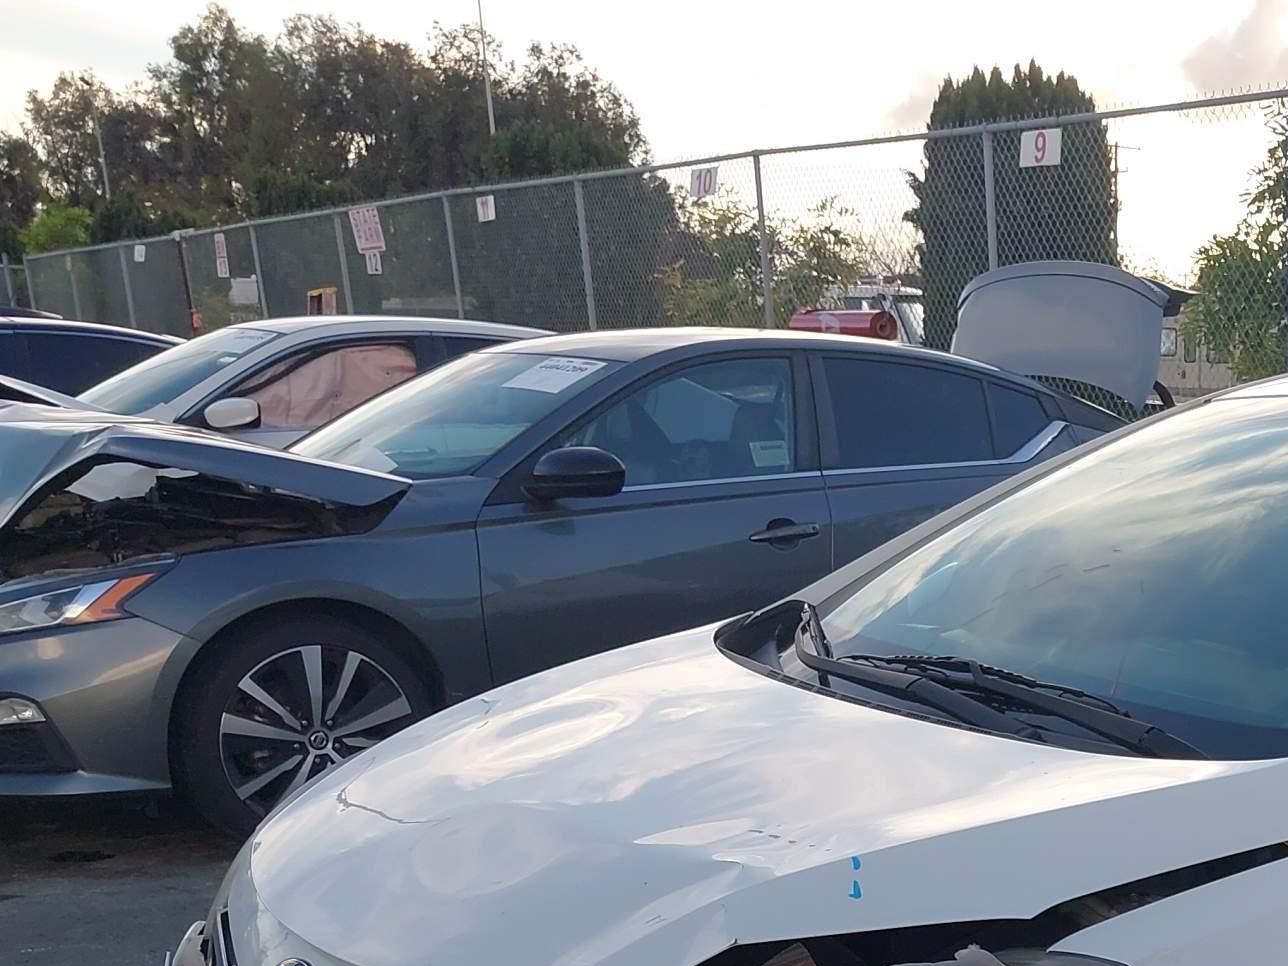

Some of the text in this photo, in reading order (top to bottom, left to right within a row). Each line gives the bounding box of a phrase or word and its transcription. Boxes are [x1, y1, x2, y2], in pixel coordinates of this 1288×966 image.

[1034, 131, 1047, 164] 9
[696, 168, 712, 196] 10
[368, 253, 380, 273] 12
